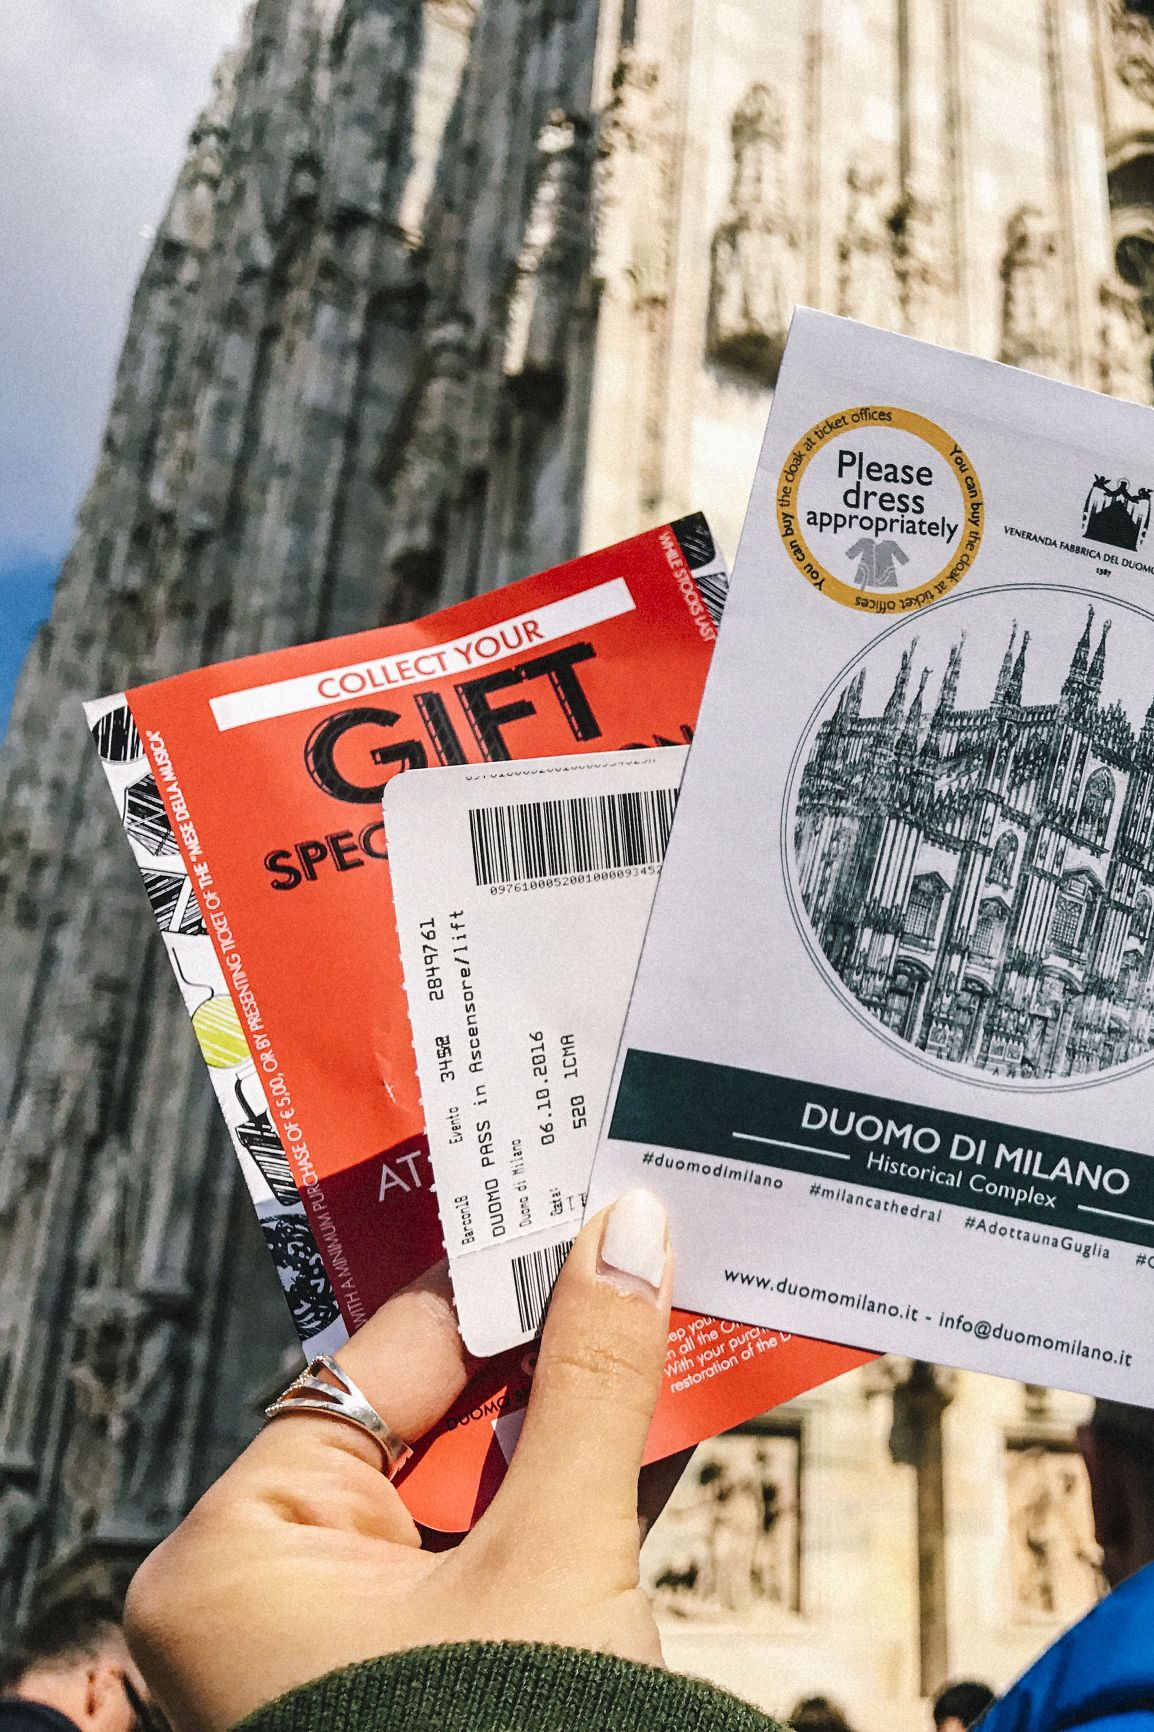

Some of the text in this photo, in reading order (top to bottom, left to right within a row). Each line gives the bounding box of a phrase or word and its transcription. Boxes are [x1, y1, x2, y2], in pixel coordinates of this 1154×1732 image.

[815, 415, 849, 441] ticket
[851, 407, 892, 423] offices
[804, 438, 816, 451] at
[949, 444, 968, 473] You
[838, 450, 933, 486] Please
[779, 485, 792, 507] the
[843, 481, 925, 514] dress
[965, 476, 978, 498] can
[781, 512, 795, 538] buy
[806, 511, 959, 544] appropriately
[968, 502, 983, 527] buy
[789, 540, 806, 562] can
[966, 531, 980, 551] the
[1004, 525, 1057, 548] VENERANDA
[1059, 541, 1101, 560] FABBRICA
[1104, 553, 1119, 566] DEL
[804, 563, 825, 591] You
[933, 581, 947, 595] at
[855, 595, 896, 613] offices
[900, 590, 934, 609] ticket
[317, 620, 545, 700] COLLECT YOUR
[304, 641, 602, 804] GIFT
[166, 780, 191, 822] DELLA
[193, 860, 214, 890] THE
[202, 890, 221, 910] OF
[210, 911, 235, 954] TICKET
[419, 917, 444, 1001] 2849761
[225, 953, 265, 1032] PRESENTING
[252, 1032, 271, 1051] BY
[260, 1049, 278, 1073] OR
[449, 909, 506, 1238] DUOMO PASS in Ascensore/lift
[529, 1031, 555, 1145] 06.10.2016
[448, 1106, 464, 1144] Evento
[570, 1095, 588, 1130] 520
[284, 1121, 303, 1141] OF
[801, 1102, 1130, 1195] DUOMO DI MILANO
[291, 1143, 325, 1213] PURCHASE
[379, 1150, 422, 1202] AT
[510, 1138, 533, 1228] Duomo di Milano
[867, 1151, 1057, 1209] Historical Complex
[642, 1151, 783, 1190] #duomodimilano
[809, 1183, 942, 1223] #milancathedral
[964, 1216, 1111, 1260] #AdottaunaGuglia
[315, 1211, 351, 1278] MINIMUM
[341, 1276, 353, 1289] A
[347, 1290, 367, 1330] WITH
[723, 1268, 919, 1322] www.duomomilano.it
[939, 1312, 1133, 1367] info@duomomilano.it
[679, 1336, 696, 1355] all
[697, 1329, 719, 1346] the
[664, 1357, 695, 1377] With
[696, 1342, 725, 1367] your
[670, 1355, 739, 1393] restoration
[740, 1342, 754, 1360] of
[755, 1337, 778, 1354] the
